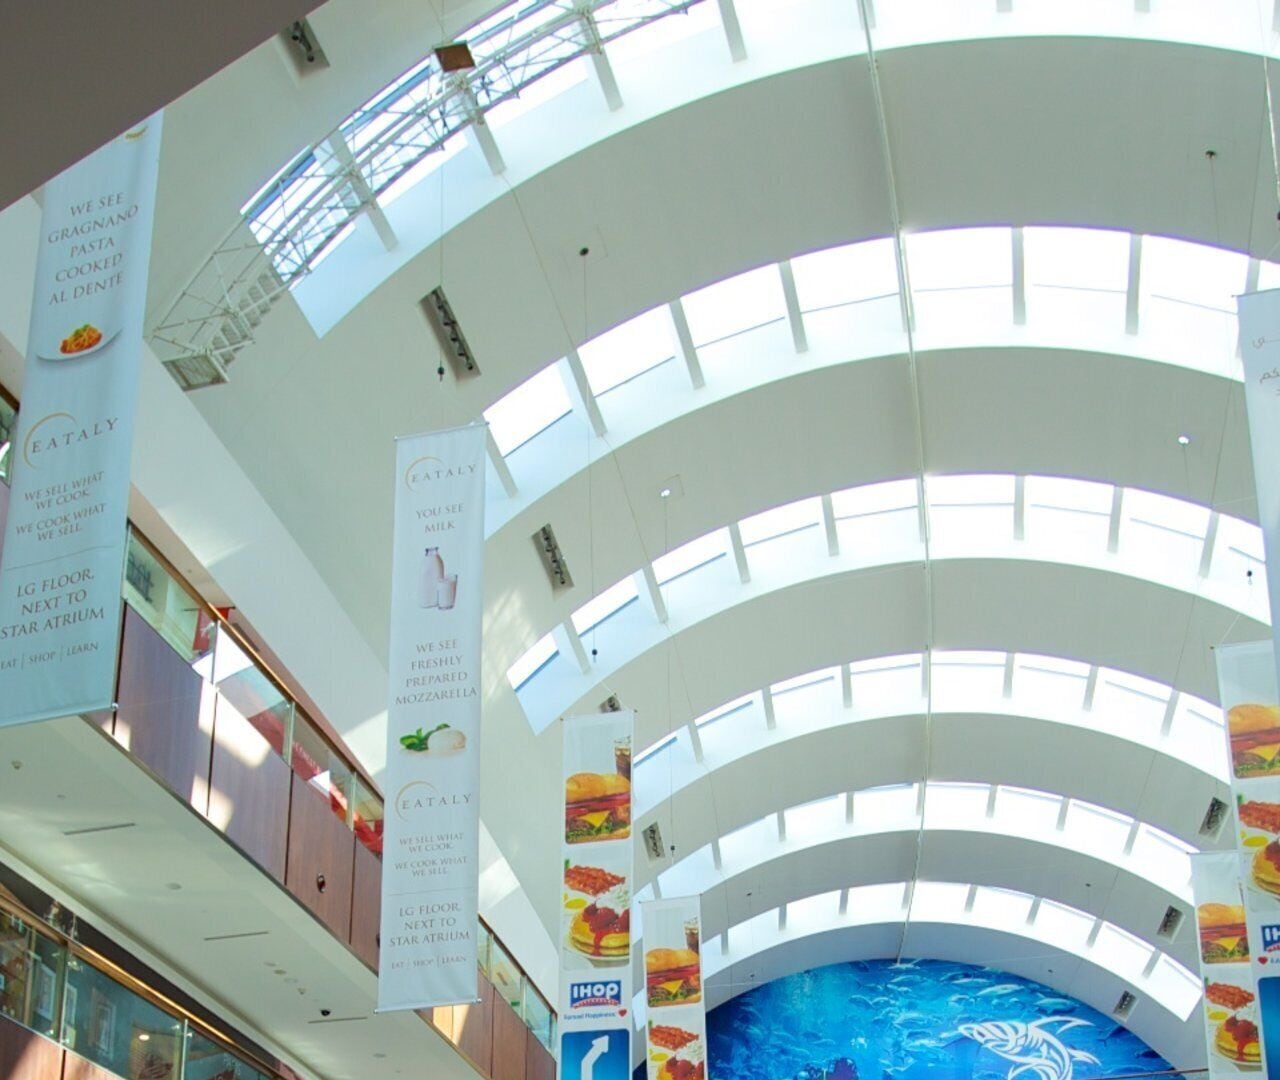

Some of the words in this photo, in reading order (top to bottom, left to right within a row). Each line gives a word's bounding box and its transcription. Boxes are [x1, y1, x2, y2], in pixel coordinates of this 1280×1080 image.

[70, 200, 93, 217] WE
[99, 192, 124, 209] SEE
[48, 204, 139, 244] GRAGNANO
[70, 236, 115, 258] PASTA
[55, 253, 123, 283] COOKED
[49, 290, 68, 306] AL
[73, 272, 124, 299] DENTE
[31, 417, 119, 453] EATALY
[412, 463, 477, 484] EATALY
[24, 490, 43, 501] WE
[46, 483, 67, 496] SELL
[71, 471, 105, 489] WHAT
[35, 499, 53, 511] WE
[416, 507, 442, 520] YOU
[445, 503, 465, 515] SEE
[16, 523, 35, 535] WE
[36, 515, 71, 532] COOK
[73, 503, 106, 521] WHAT
[424, 520, 456, 534] MILK
[37, 530, 55, 542] WE
[17, 582, 36, 598] LG
[41, 568, 95, 592] FLOOR,
[21, 595, 62, 616] NEXT
[66, 589, 88, 605] TO
[0, 621, 39, 640] STAR
[43, 607, 105, 632] ATRIUM
[416, 642, 435, 654] WE
[438, 638, 459, 650] SEE
[0, 658, 17, 671] EAT
[28, 651, 57, 663] SHOP
[66, 641, 99, 656] LEARN
[411, 655, 463, 671] FRESHLY
[405, 672, 468, 688] PREPARED
[395, 687, 478, 706] MOZZARELLA
[401, 793, 472, 810] EATALY
[437, 832, 464, 843] WHAT
[411, 859, 439, 869] COOK
[440, 856, 468, 866] WHAT
[399, 905, 415, 917] LG
[404, 919, 437, 931] NEXT
[440, 917, 457, 928] TO
[389, 935, 419, 947] STAR
[421, 930, 471, 945] ATRIUM
[572, 982, 620, 1001] IHOP
